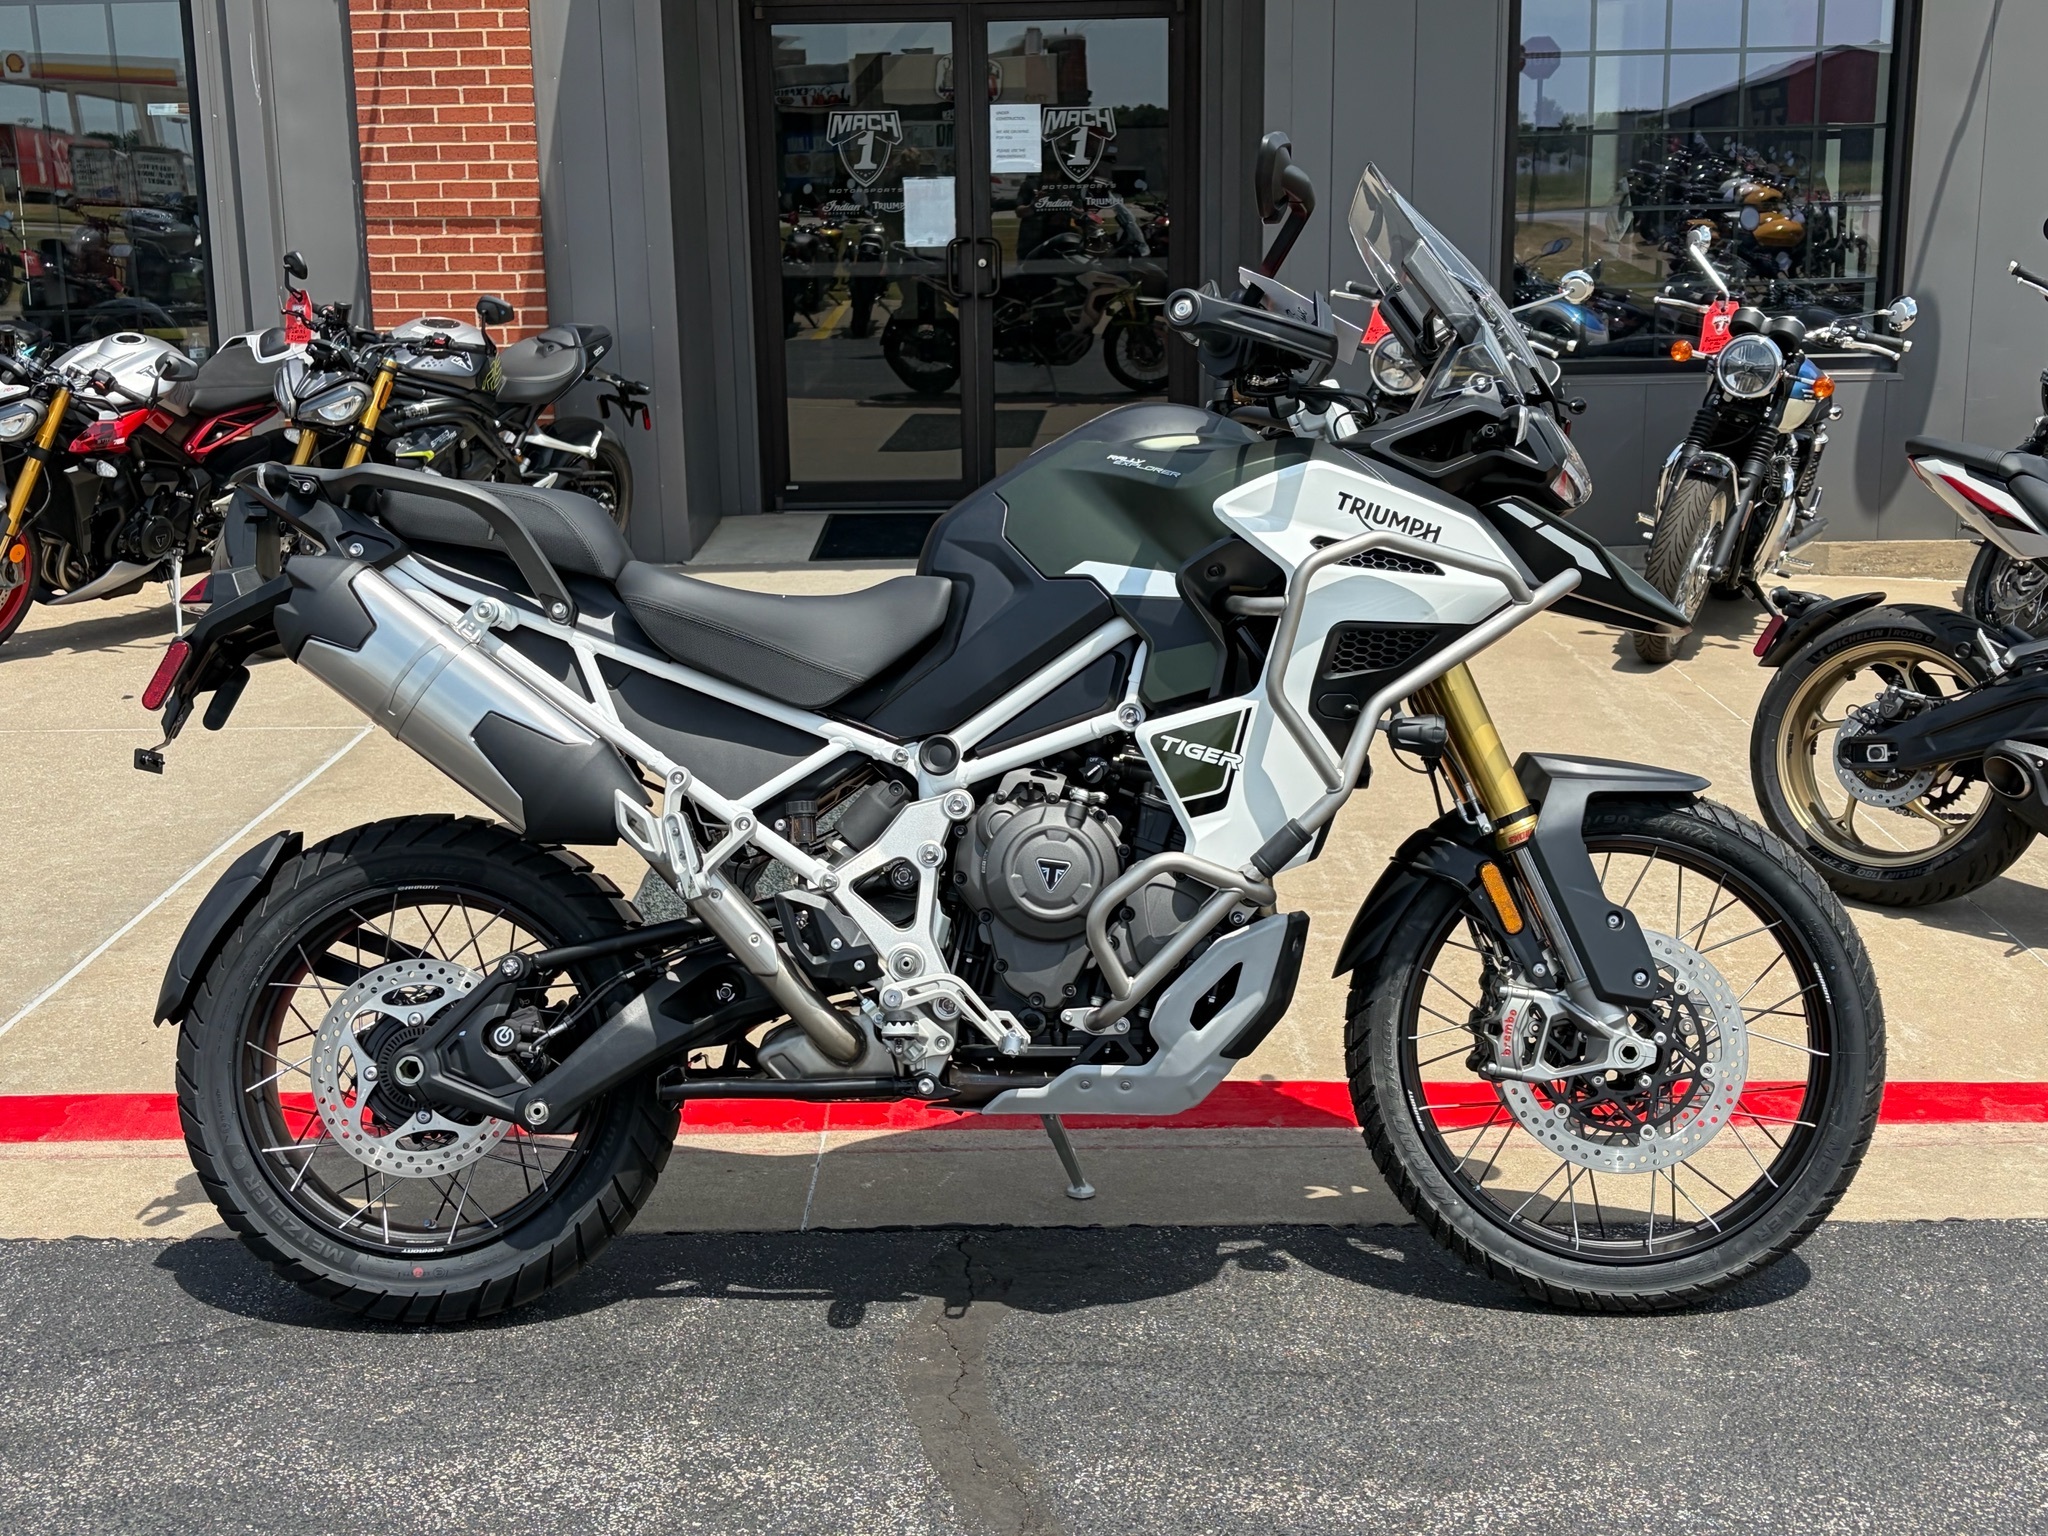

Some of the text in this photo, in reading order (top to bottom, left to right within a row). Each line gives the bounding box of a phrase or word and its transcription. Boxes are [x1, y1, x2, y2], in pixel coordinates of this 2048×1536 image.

[830, 114, 899, 139] MACH
[1044, 109, 1113, 135] MACH
[854, 131, 877, 169] 1
[1067, 126, 1090, 165] 1
[822, 200, 861, 212] Indian
[872, 201, 905, 212] TRIUMP
[1034, 196, 1073, 208] Indian
[1085, 197, 1124, 208] TRIUMPH
[1107, 454, 1147, 464] RALLY
[1112, 460, 1182, 478] EXPLORER
[1338, 491, 1442, 544] TRIUMPH
[1827, 629, 1884, 653] MICHELIN
[1893, 629, 1924, 640] ROAD
[1160, 734, 1243, 771] TIGER
[1501, 1009, 1517, 1057] brembo
[1753, 1137, 1842, 1243] METZELER
[243, 1177, 346, 1265] METZELER
